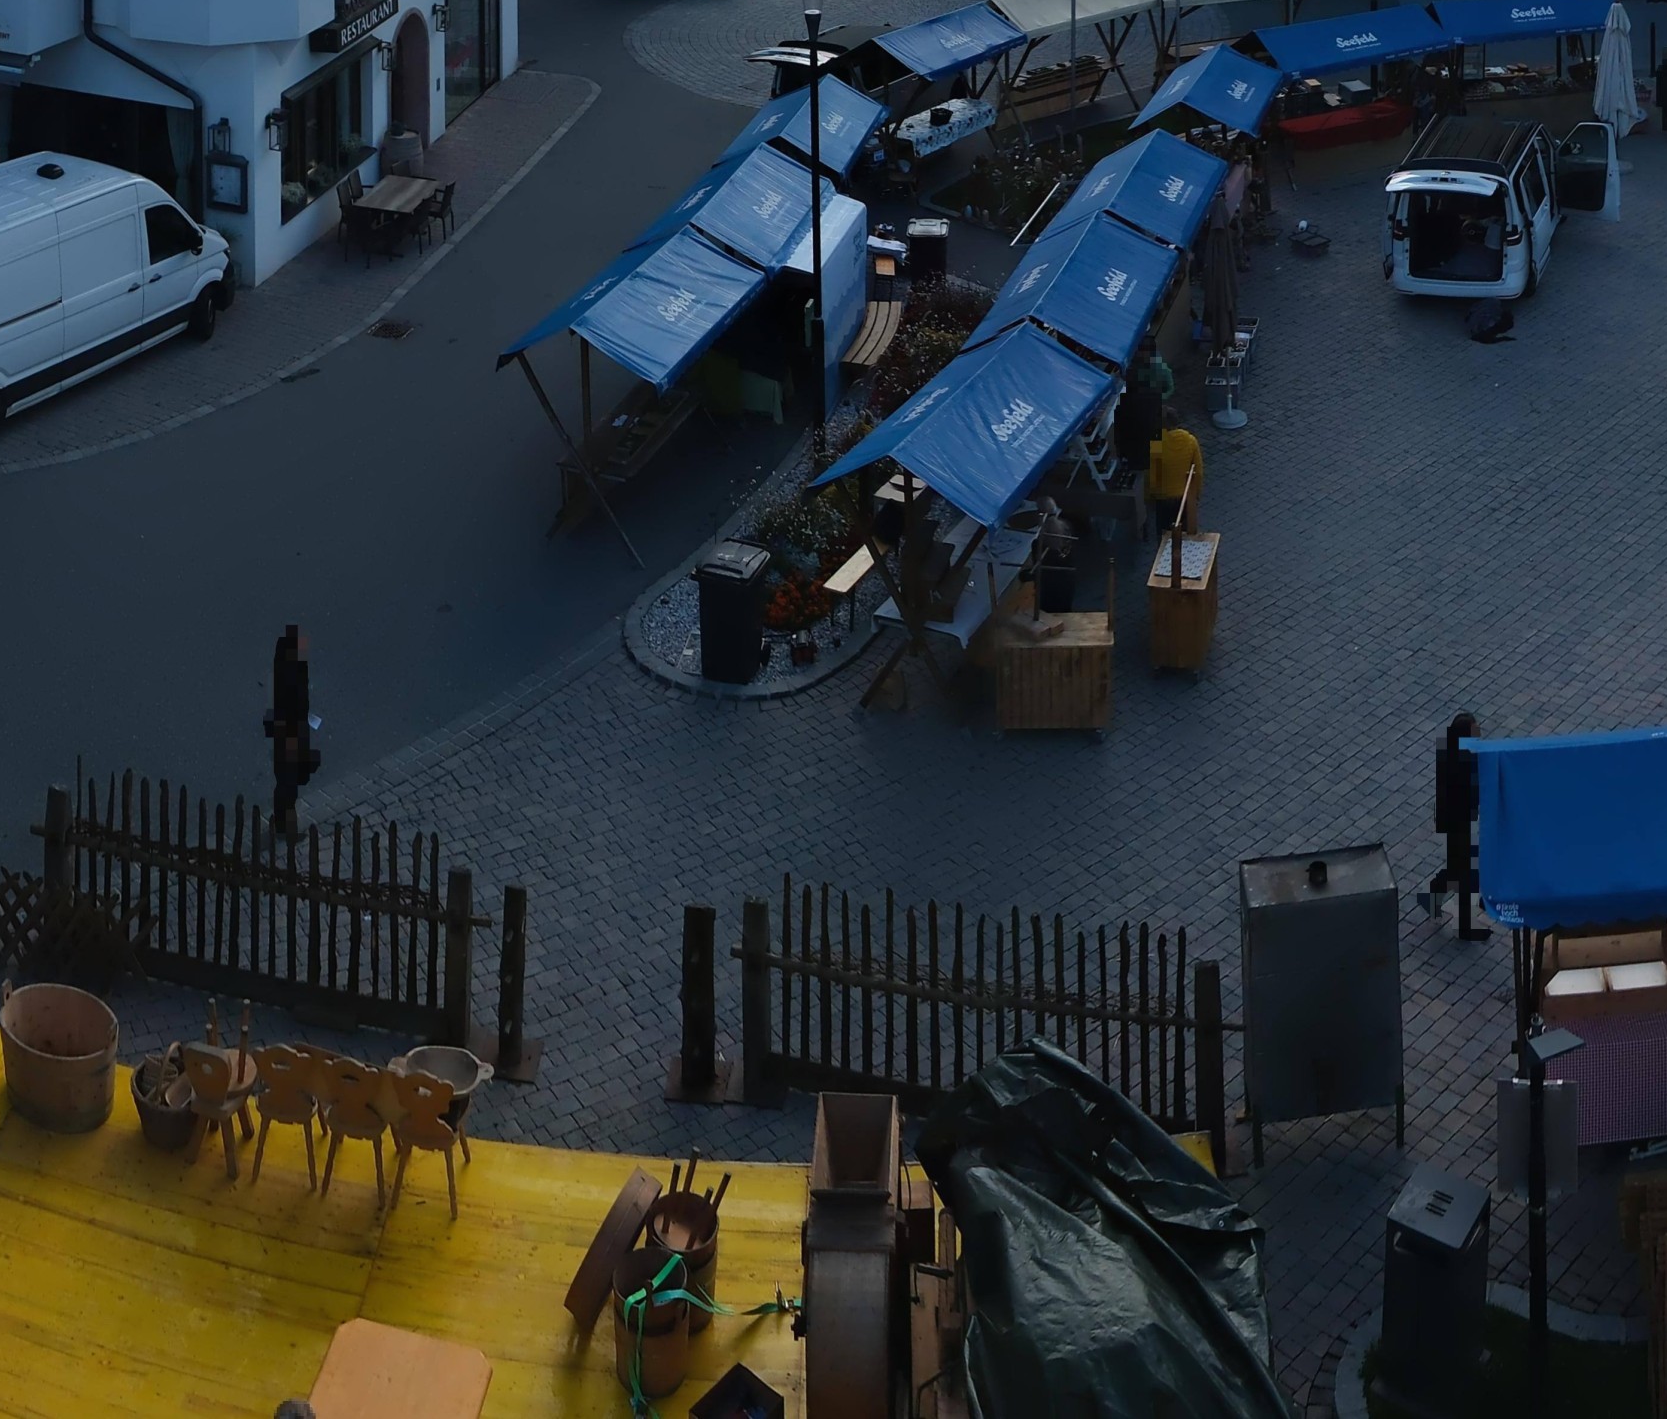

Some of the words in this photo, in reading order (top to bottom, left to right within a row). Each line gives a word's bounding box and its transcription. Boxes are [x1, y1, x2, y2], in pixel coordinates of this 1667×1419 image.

[1511, 6, 1554, 18] Seefeld
[1336, 32, 1377, 48] Seefeld
[991, 398, 1033, 442] Seefeld
